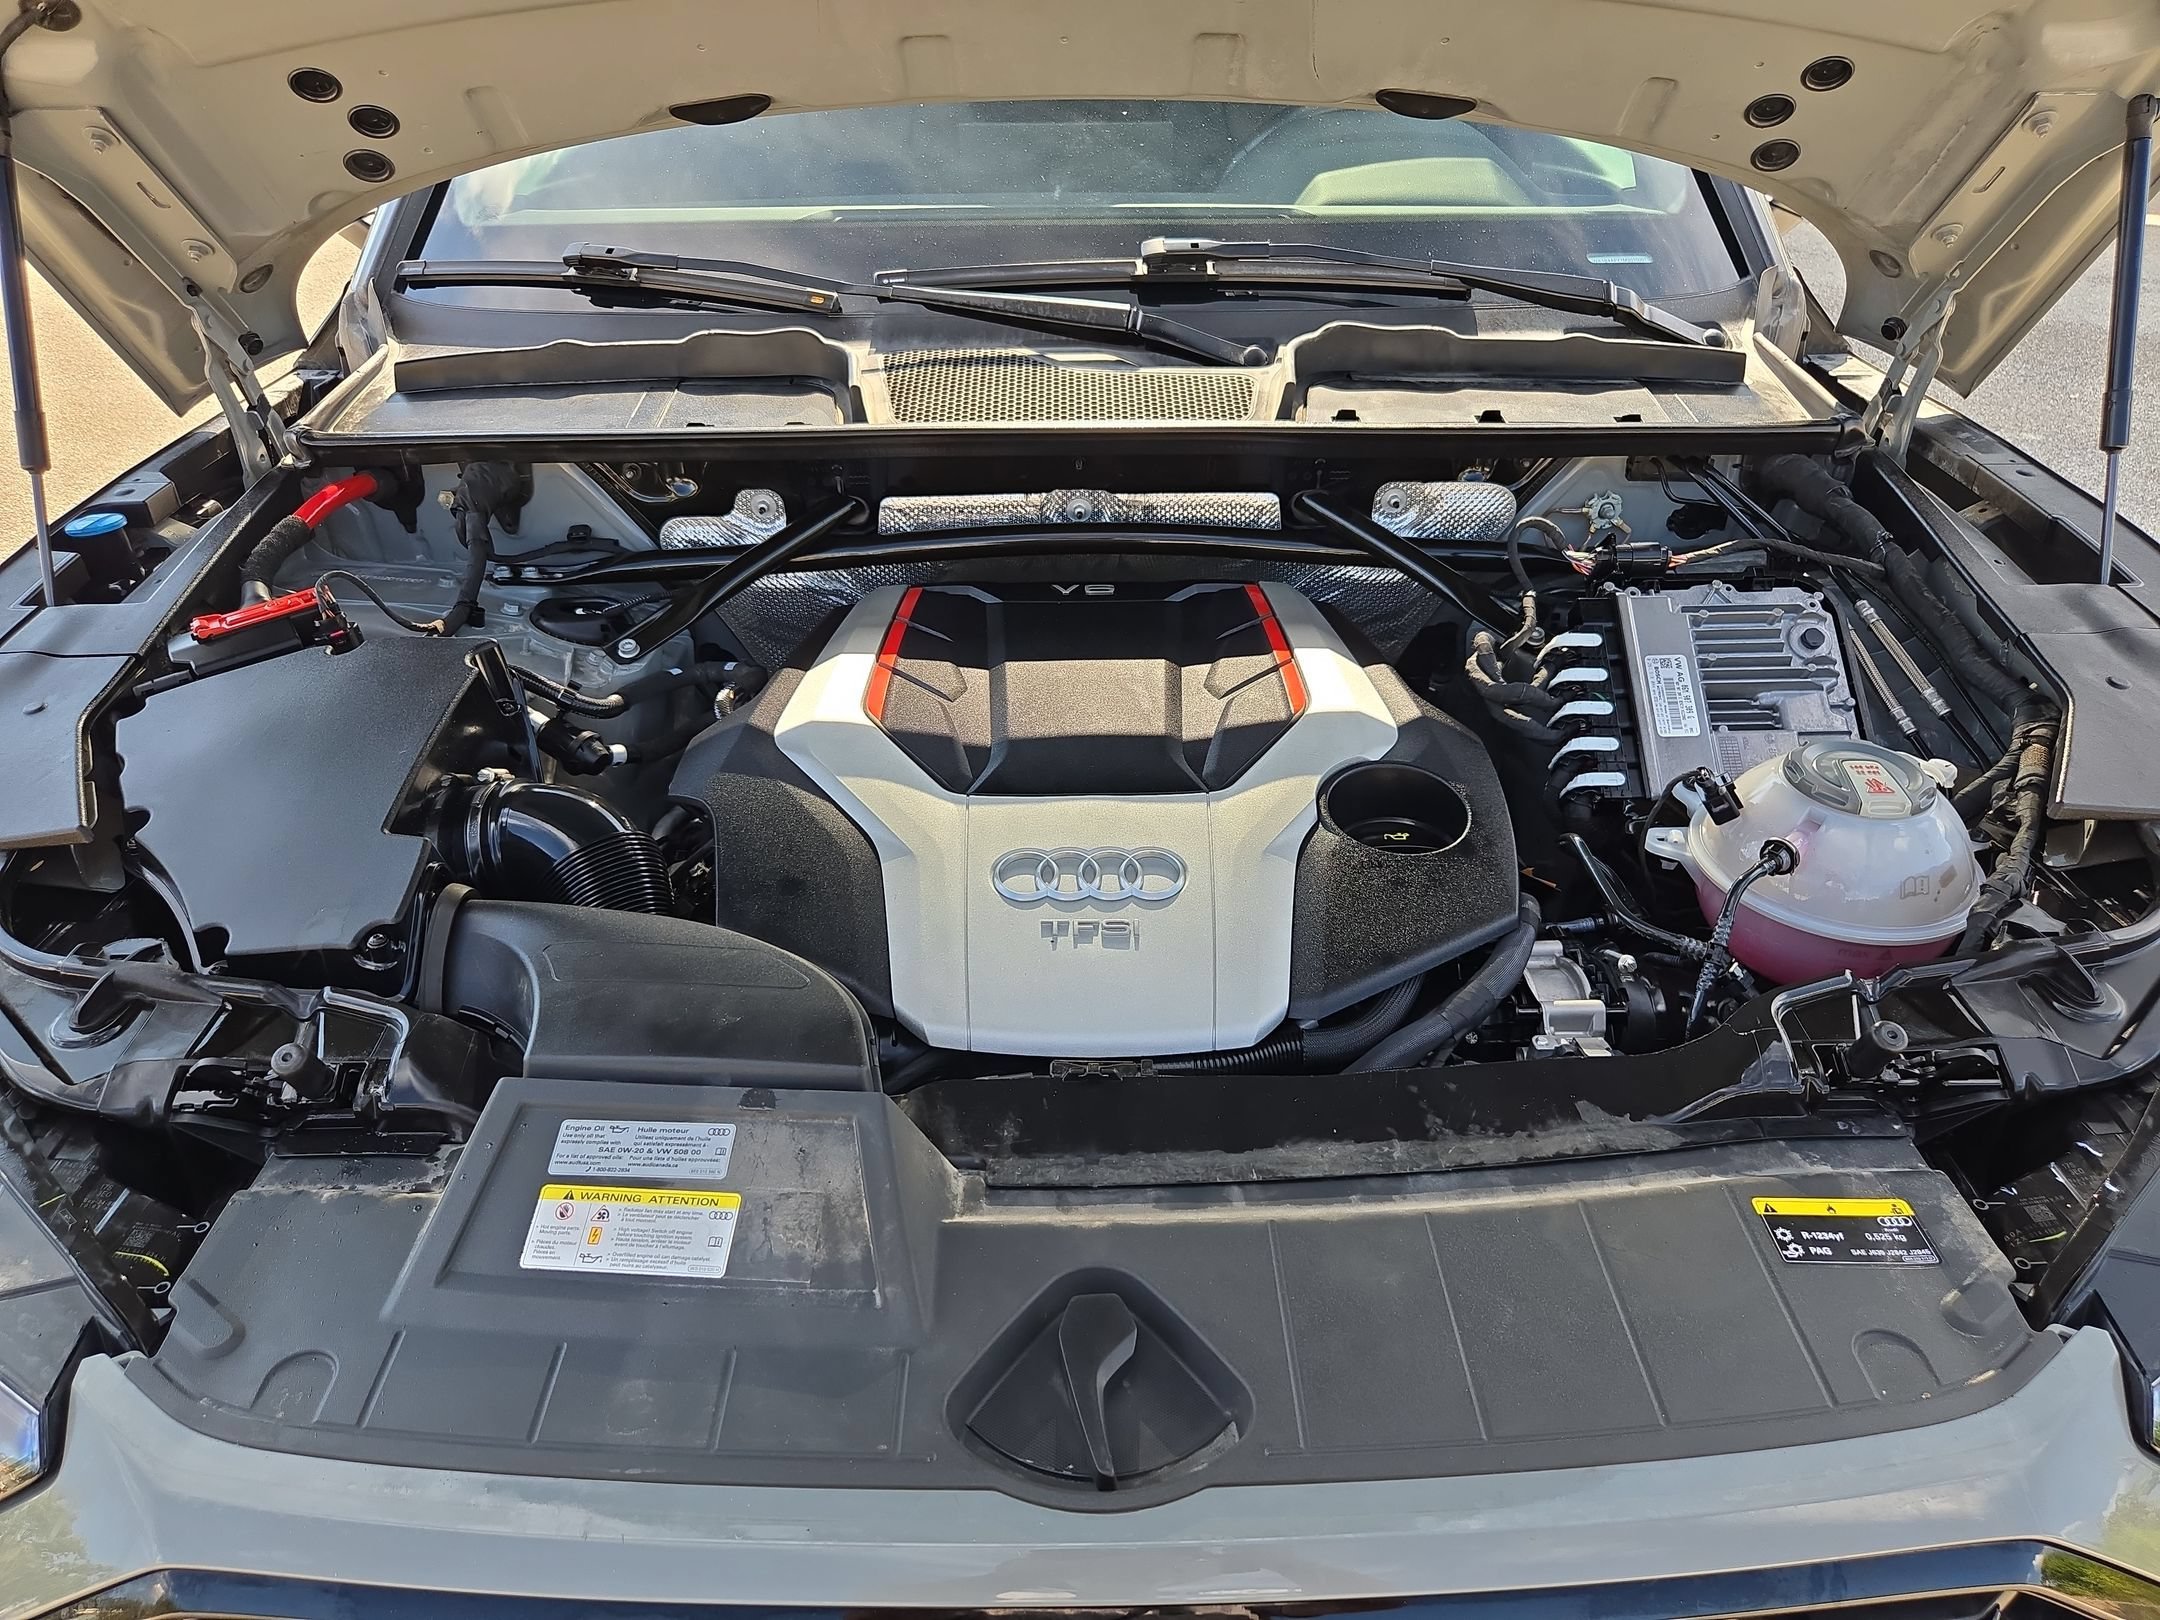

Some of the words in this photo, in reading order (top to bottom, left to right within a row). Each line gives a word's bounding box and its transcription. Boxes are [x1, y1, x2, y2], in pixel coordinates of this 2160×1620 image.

[1051, 584, 1115, 595] V6
[1674, 656, 1682, 670] VW
[1677, 672, 1685, 682] AG
[1040, 919, 1139, 951] TFSI
[580, 1192, 642, 1203] WARNING
[648, 1195, 720, 1207] ATTENTION
[1800, 1231, 1845, 1242] R-1234yf
[1864, 1232, 1890, 1242] 0,525
[1892, 1232, 1907, 1242] kg
[1808, 1246, 1833, 1256] PAG
